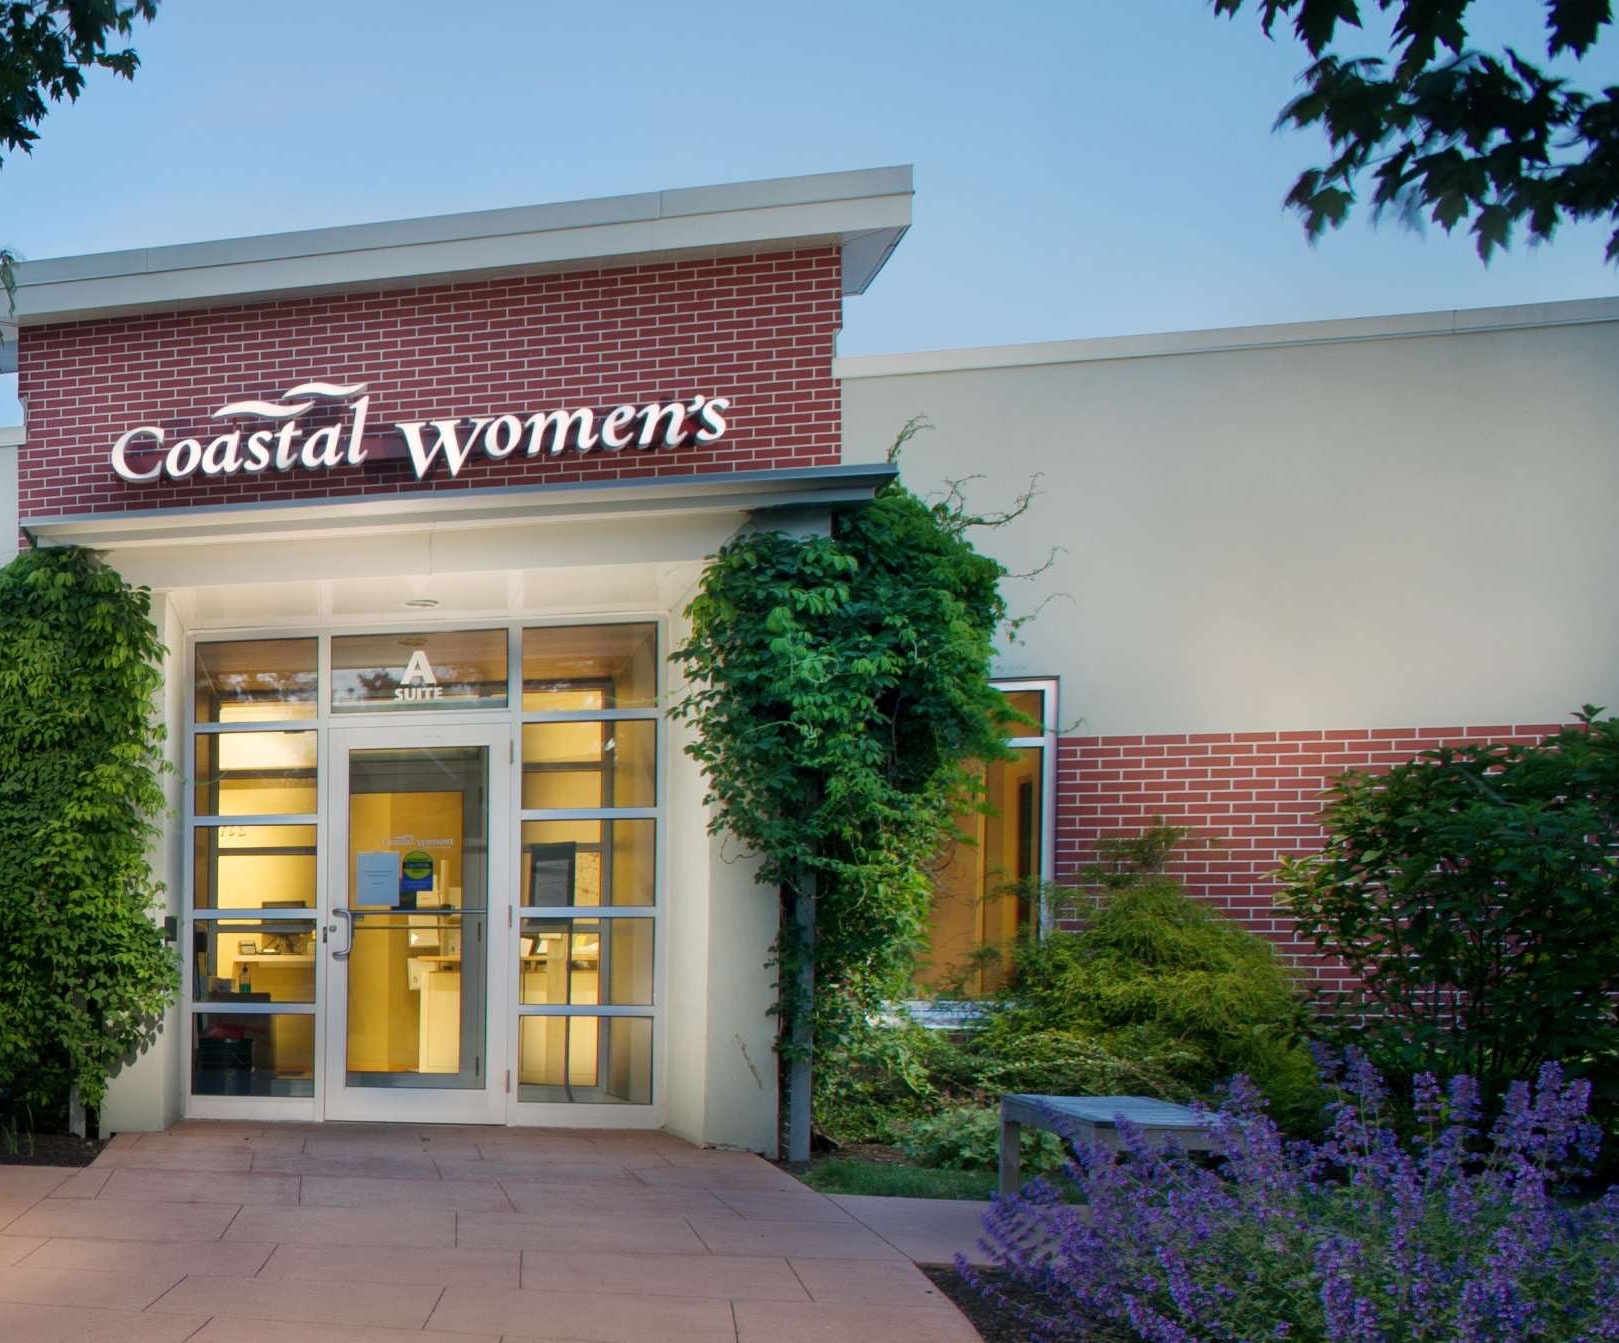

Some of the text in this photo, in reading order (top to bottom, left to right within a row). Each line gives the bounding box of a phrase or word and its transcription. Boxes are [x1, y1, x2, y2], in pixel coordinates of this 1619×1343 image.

[111, 394, 730, 483] Coastal Women's
[400, 650, 437, 685] A
[394, 687, 444, 701] SUITE
